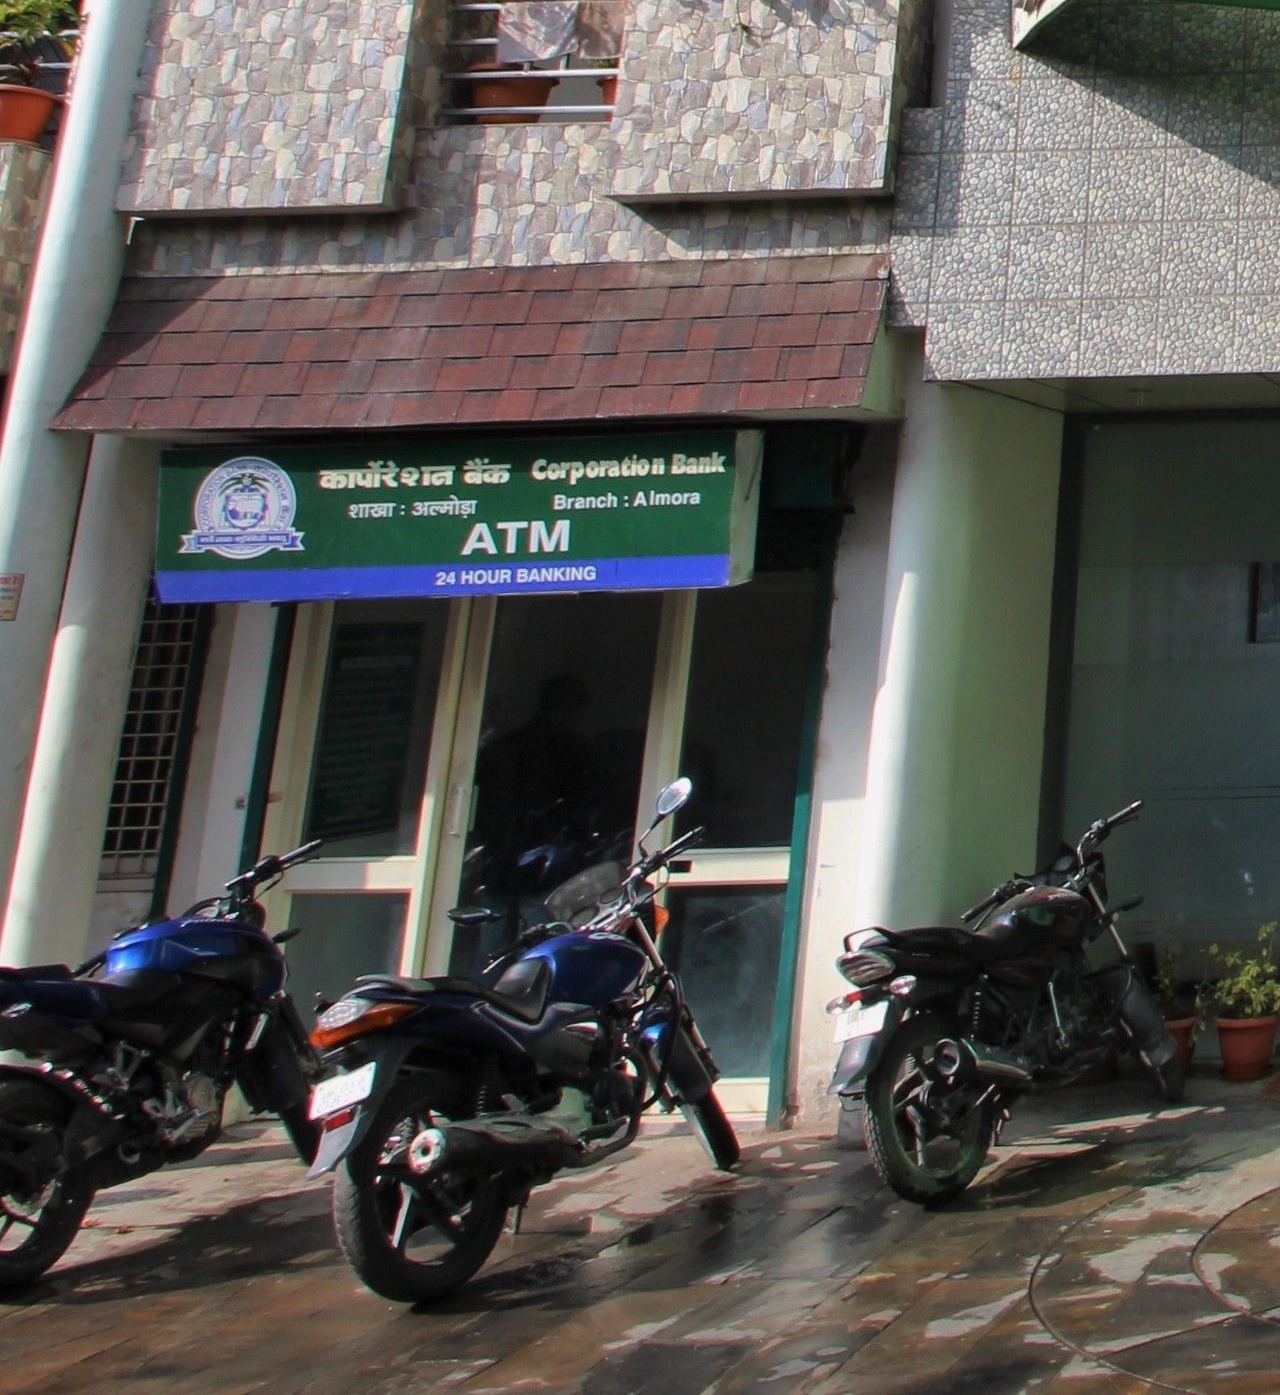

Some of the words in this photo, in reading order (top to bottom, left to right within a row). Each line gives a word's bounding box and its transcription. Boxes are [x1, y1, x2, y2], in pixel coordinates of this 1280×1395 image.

[463, 458, 511, 484] बैंक
[531, 454, 665, 485] Corporation
[671, 452, 727, 474] Bank
[348, 502, 396, 518] शाखा
[411, 494, 477, 518] अल्मोड़ा
[553, 492, 617, 510] Branch
[633, 491, 700, 507] Almora
[460, 519, 571, 556] ATM
[436, 571, 456, 586] 24
[460, 569, 511, 585] HOUR
[516, 566, 597, 583] BANKING
